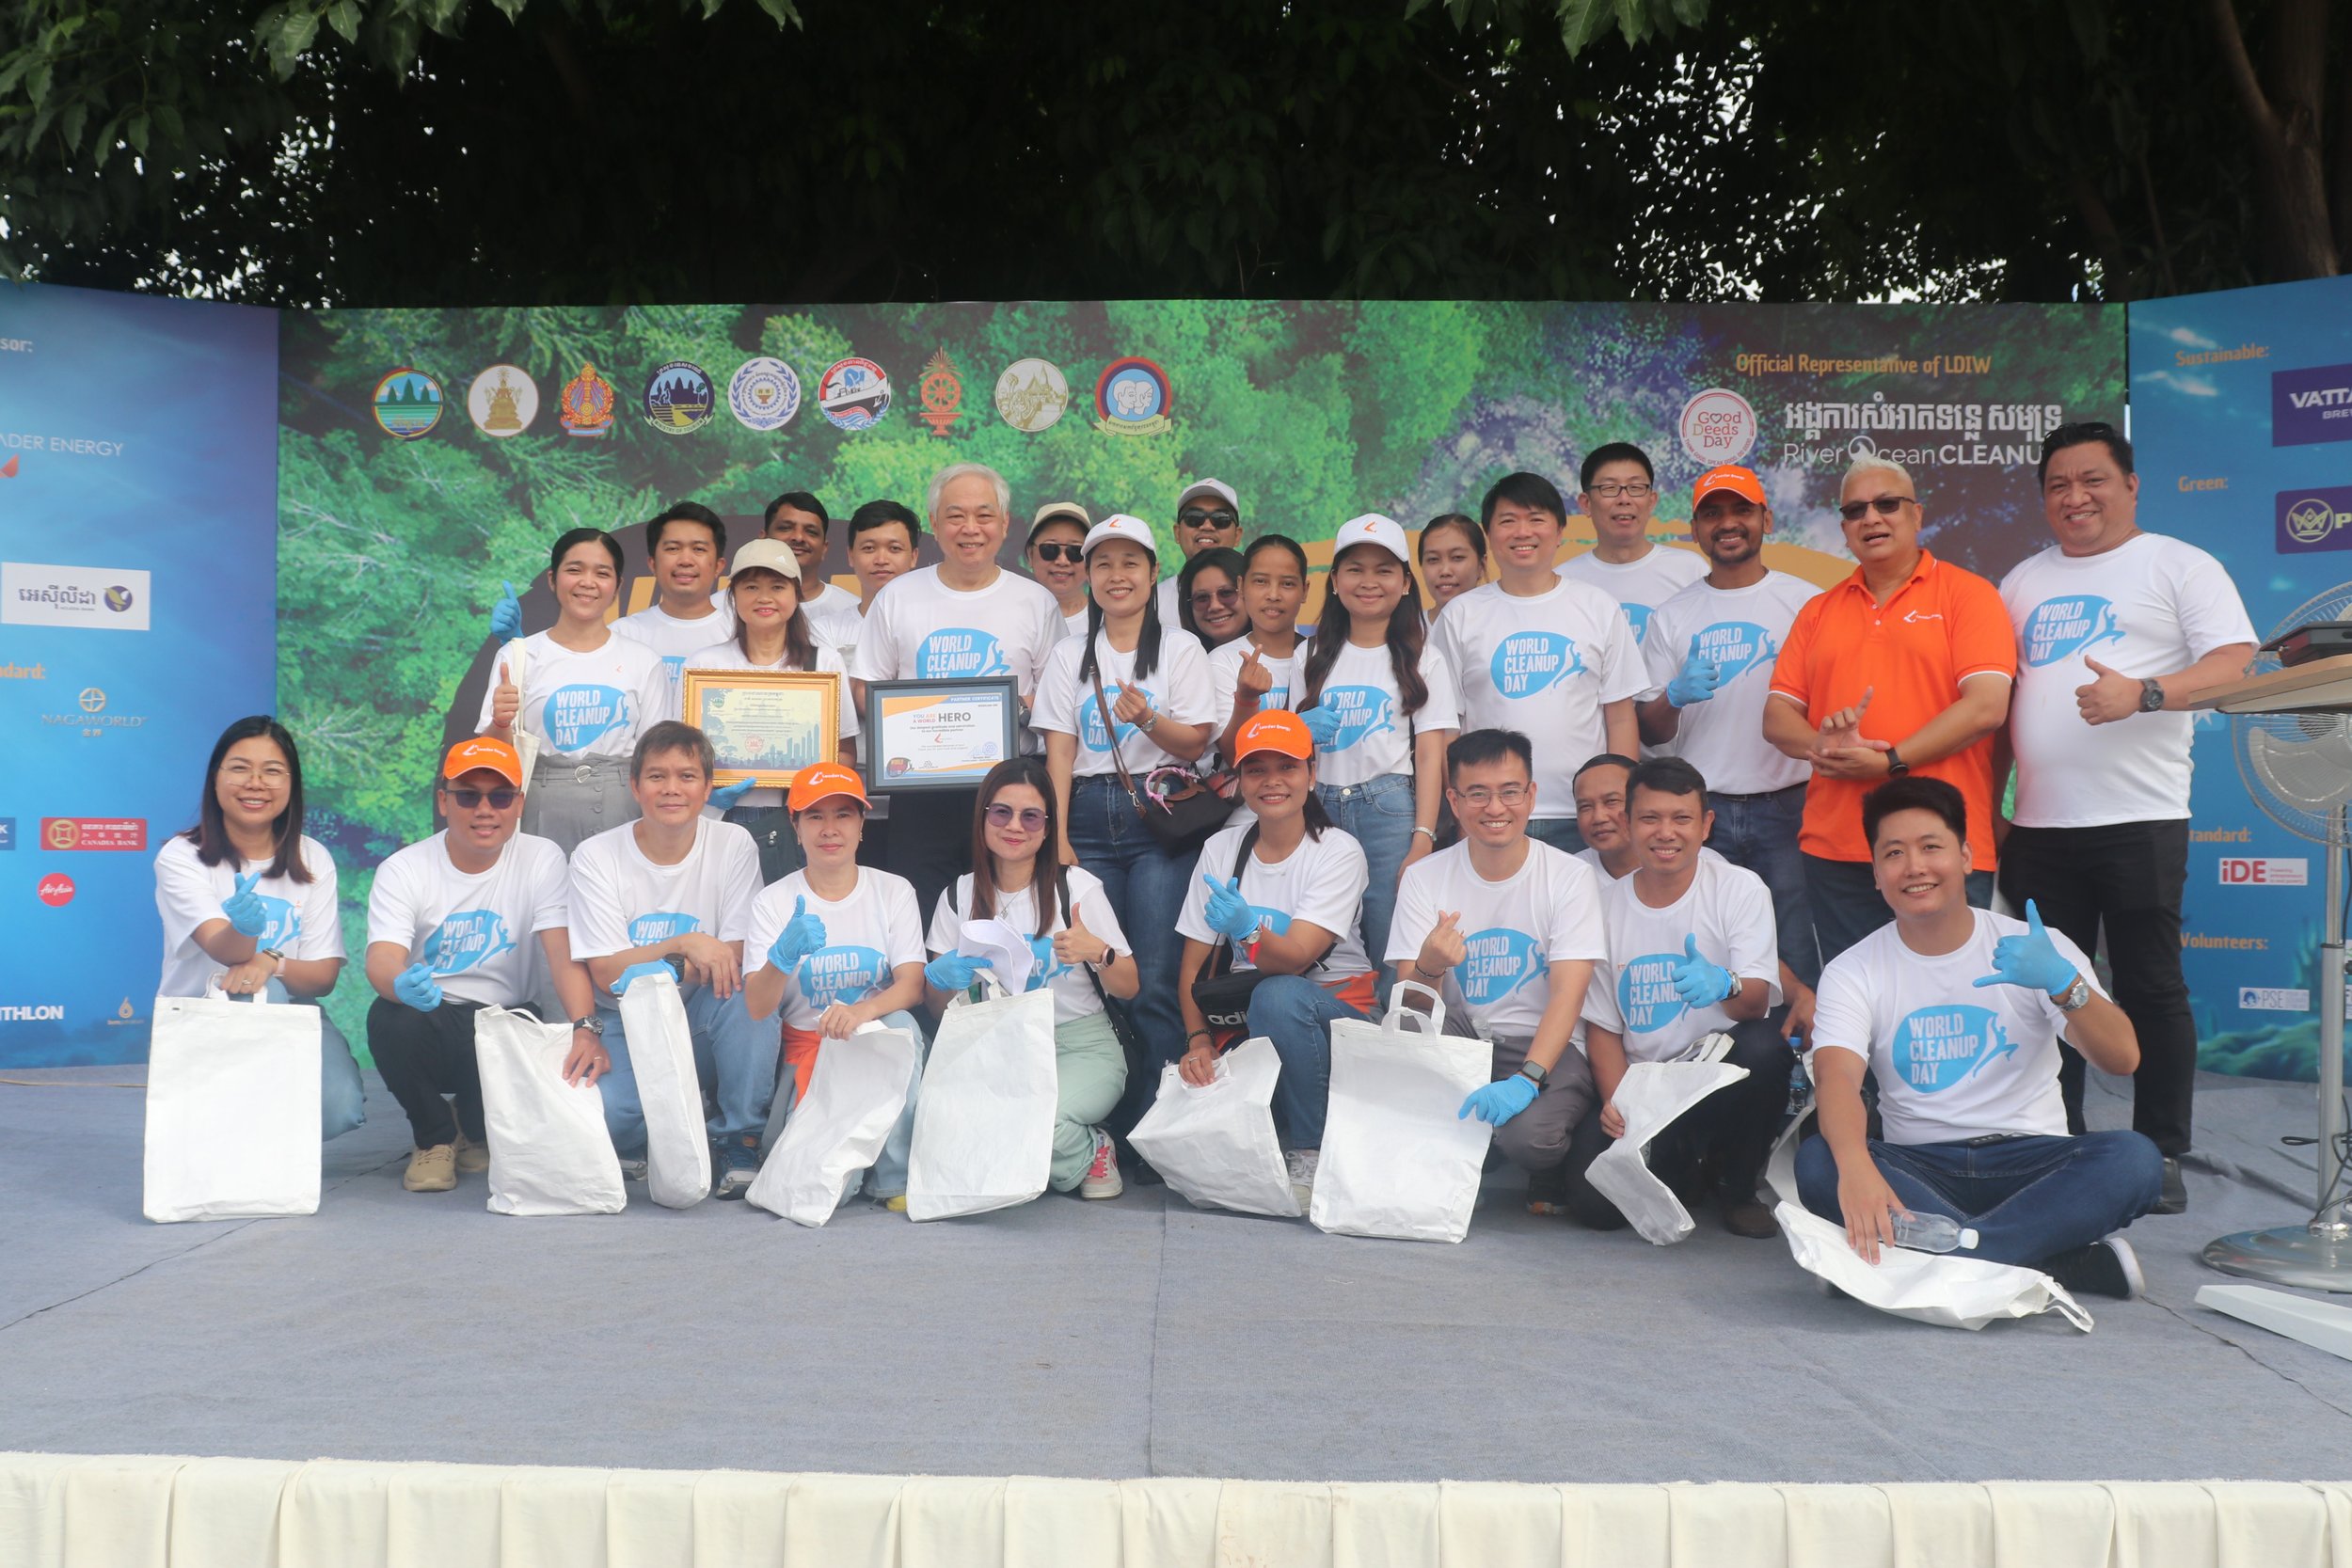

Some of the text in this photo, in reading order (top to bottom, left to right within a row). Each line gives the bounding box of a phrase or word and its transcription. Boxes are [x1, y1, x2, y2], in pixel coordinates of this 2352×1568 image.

[2175, 342, 2269, 367] Sustainable:
[1736, 354, 1992, 376] Official Representative of LDIW
[1693, 423, 1740, 436] Deeds
[50, 437, 123, 456] ENERGY
[1704, 436, 1733, 449] Day
[1785, 444, 1844, 464] River
[1940, 444, 2042, 466] CLEANU
[2178, 475, 2229, 492] Green:
[2037, 601, 2085, 622] WORLD
[1700, 627, 1742, 648] WORLD
[2032, 619, 2090, 642] CLEANUP
[929, 635, 972, 653] WORLD
[1505, 638, 1549, 657] WORLD
[2030, 641, 2055, 662] DAY
[927, 653, 981, 673] CLEANUP
[1504, 657, 1560, 674] CLEANUP
[1504, 674, 1529, 693] DAY
[556, 689, 601, 706] WORLD
[554, 706, 611, 726] CLEANUP
[938, 712, 971, 722] HERO
[555, 727, 579, 746] DAY
[2189, 826, 2252, 843] tandard:
[2222, 860, 2266, 882] iDE
[636, 920, 675, 939] WORLD
[1466, 936, 1509, 959] WORLD
[2180, 932, 2268, 950] Volunteers:
[810, 952, 860, 975] WORLD
[1467, 956, 1521, 978] CLEANUP
[1629, 961, 1676, 985] WORLD
[811, 969, 872, 991] CLEANUP
[1466, 976, 1489, 997] DAY
[1629, 982, 1682, 1006] CLEANU
[2263, 990, 2283, 1008] PSE
[0, 1006, 64, 1021] THLON
[1207, 1010, 1248, 1025] adi
[1629, 1006, 1655, 1026] DAY
[1909, 1013, 1964, 1038] WORLD
[1910, 1035, 1979, 1062] CLEANUP
[1911, 1062, 1940, 1085] DAY
